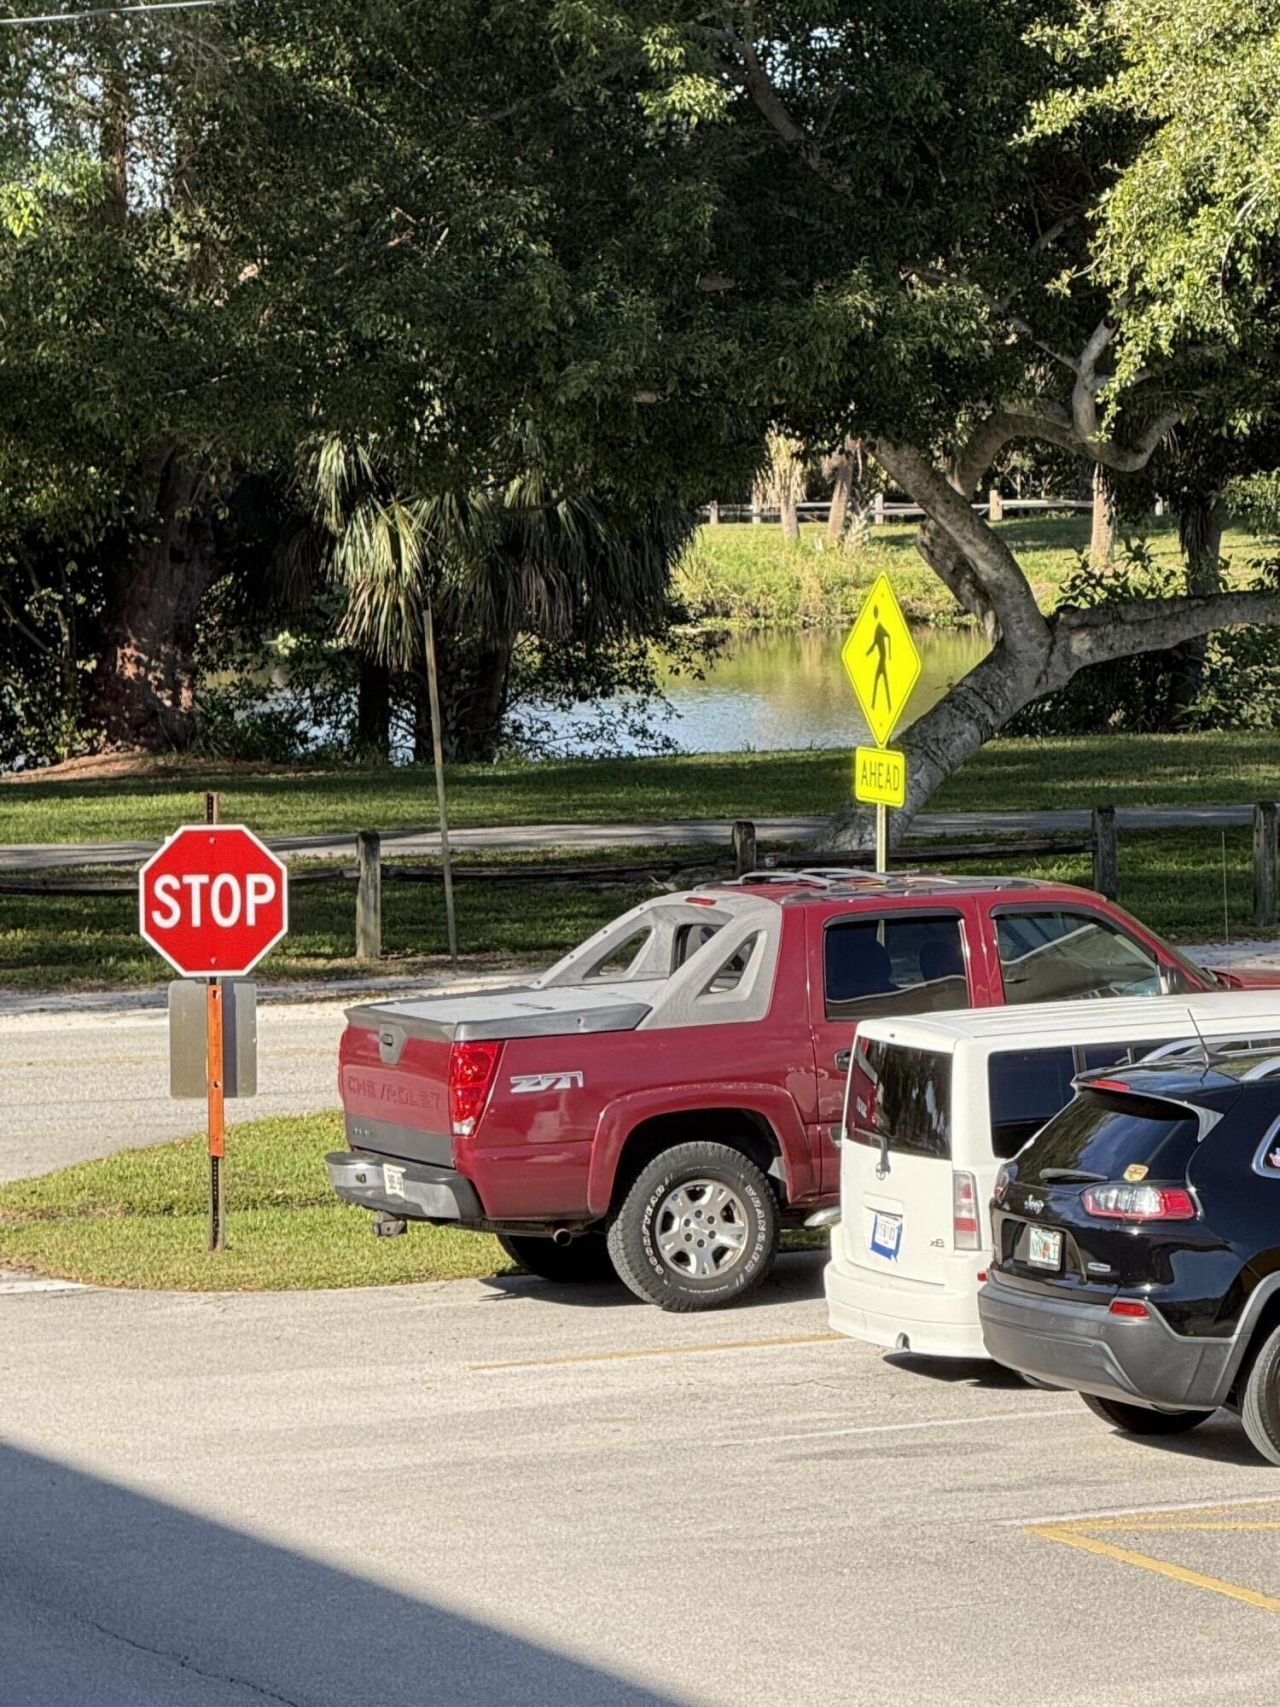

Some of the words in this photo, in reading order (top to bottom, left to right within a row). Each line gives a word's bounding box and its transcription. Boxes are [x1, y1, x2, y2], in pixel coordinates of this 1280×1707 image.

[860, 760, 900, 791] AHEAD
[151, 873, 276, 928] STOP
[510, 1071, 583, 1093] Z71
[641, 1184, 666, 1275] GOODYEAR
[744, 1185, 767, 1273] WRANGLER
